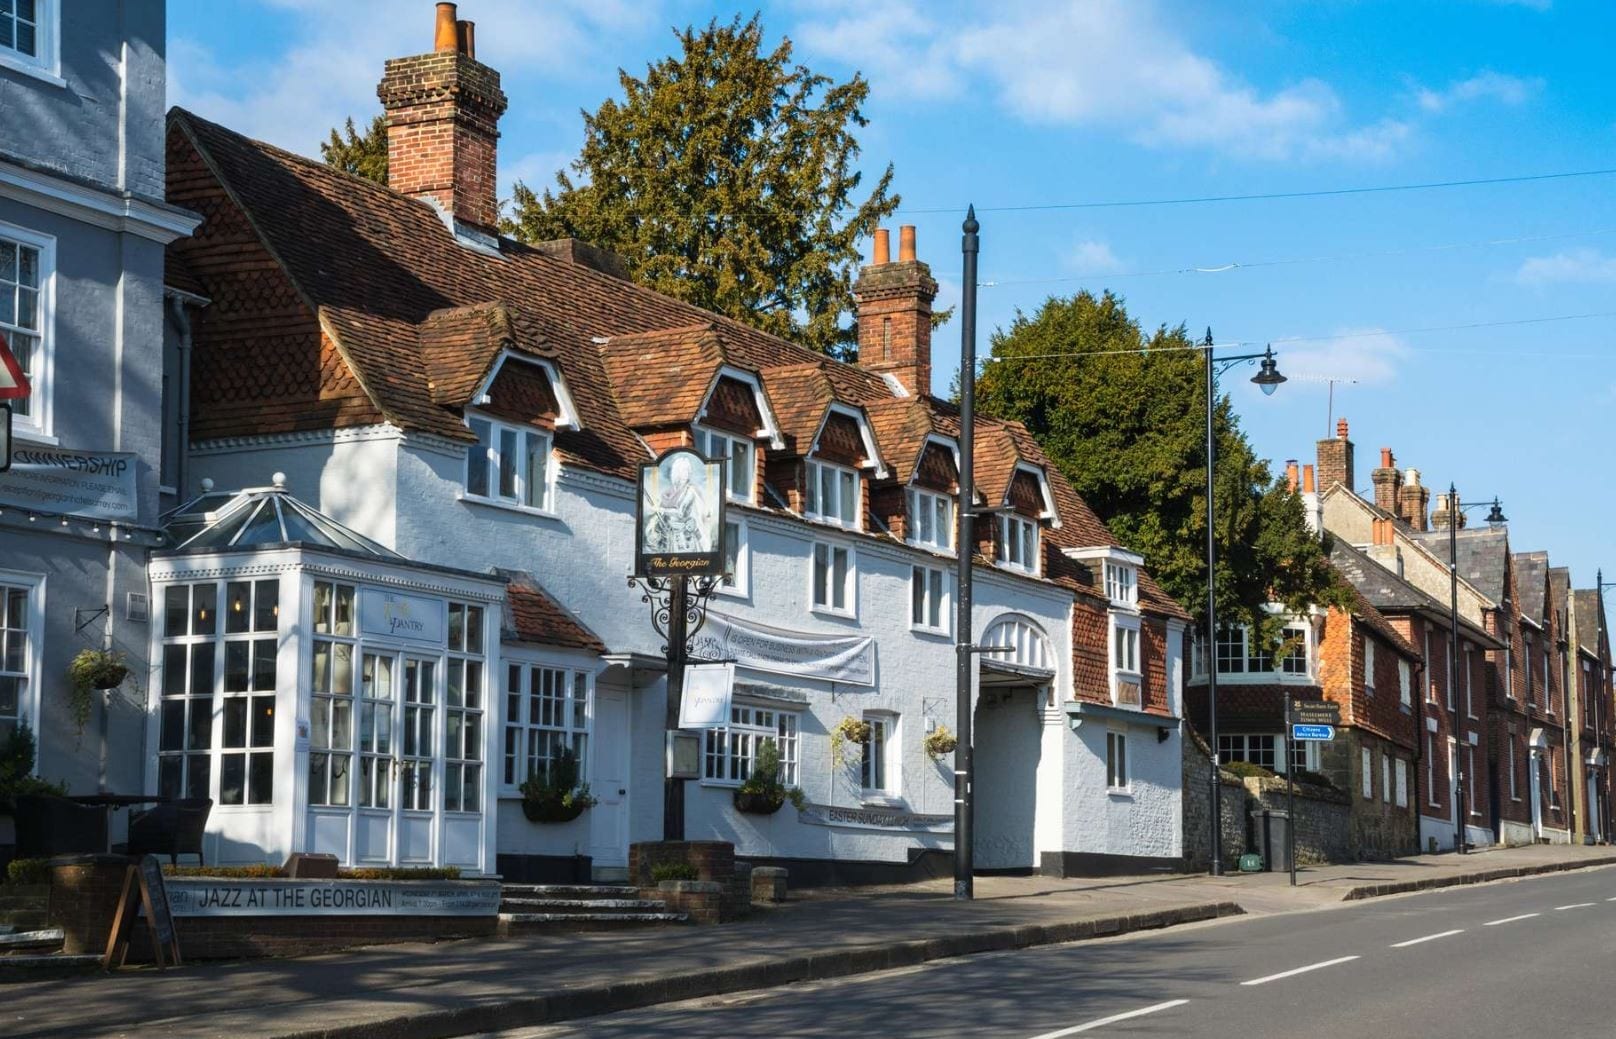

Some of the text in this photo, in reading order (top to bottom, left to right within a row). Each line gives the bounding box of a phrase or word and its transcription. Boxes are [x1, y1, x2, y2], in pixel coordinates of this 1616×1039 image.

[14, 450, 128, 478] OWNERSHIP
[669, 557, 710, 569] Georgian
[829, 809, 857, 823] EASTER
[199, 887, 243, 908] JAZZ
[247, 887, 269, 908] AT
[271, 887, 305, 908] THE
[310, 887, 392, 908] GEORGIAN
